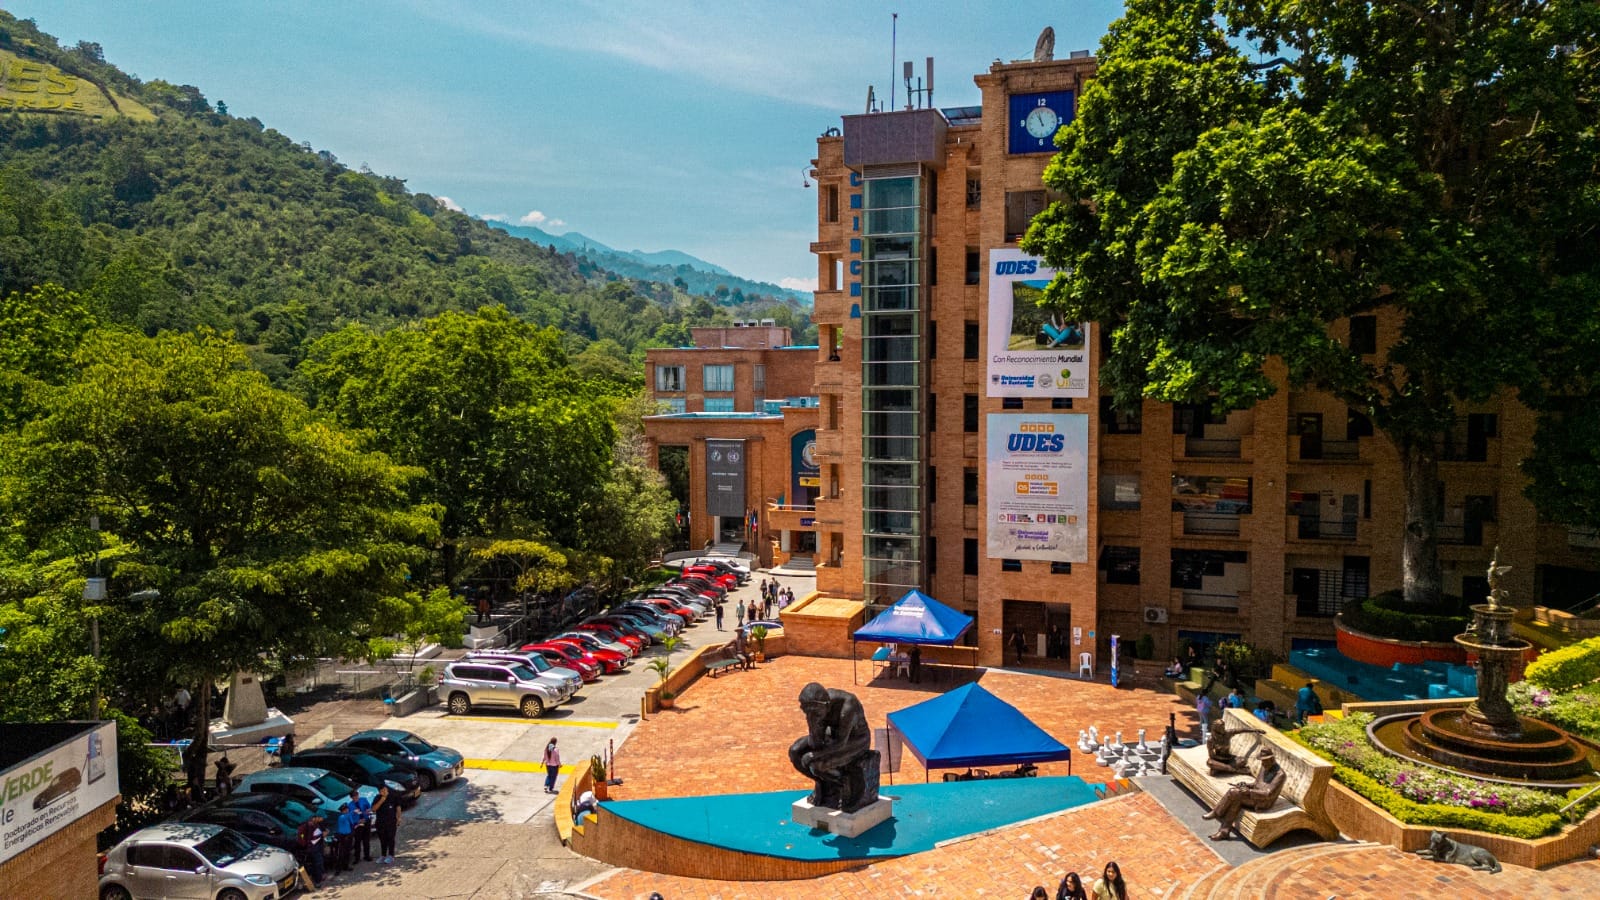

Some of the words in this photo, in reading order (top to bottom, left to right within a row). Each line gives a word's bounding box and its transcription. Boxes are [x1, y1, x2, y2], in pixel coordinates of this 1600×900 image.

[1037, 98, 1046, 106] 12
[996, 260, 1037, 276] UDES
[1057, 355, 1083, 363] Mundial
[1008, 434, 1064, 452] UDES
[4, 816, 39, 840] Doctorado
[48, 796, 77, 814] Recursos
[4, 823, 44, 850] Energéticos
[44, 803, 79, 825] Renovables
